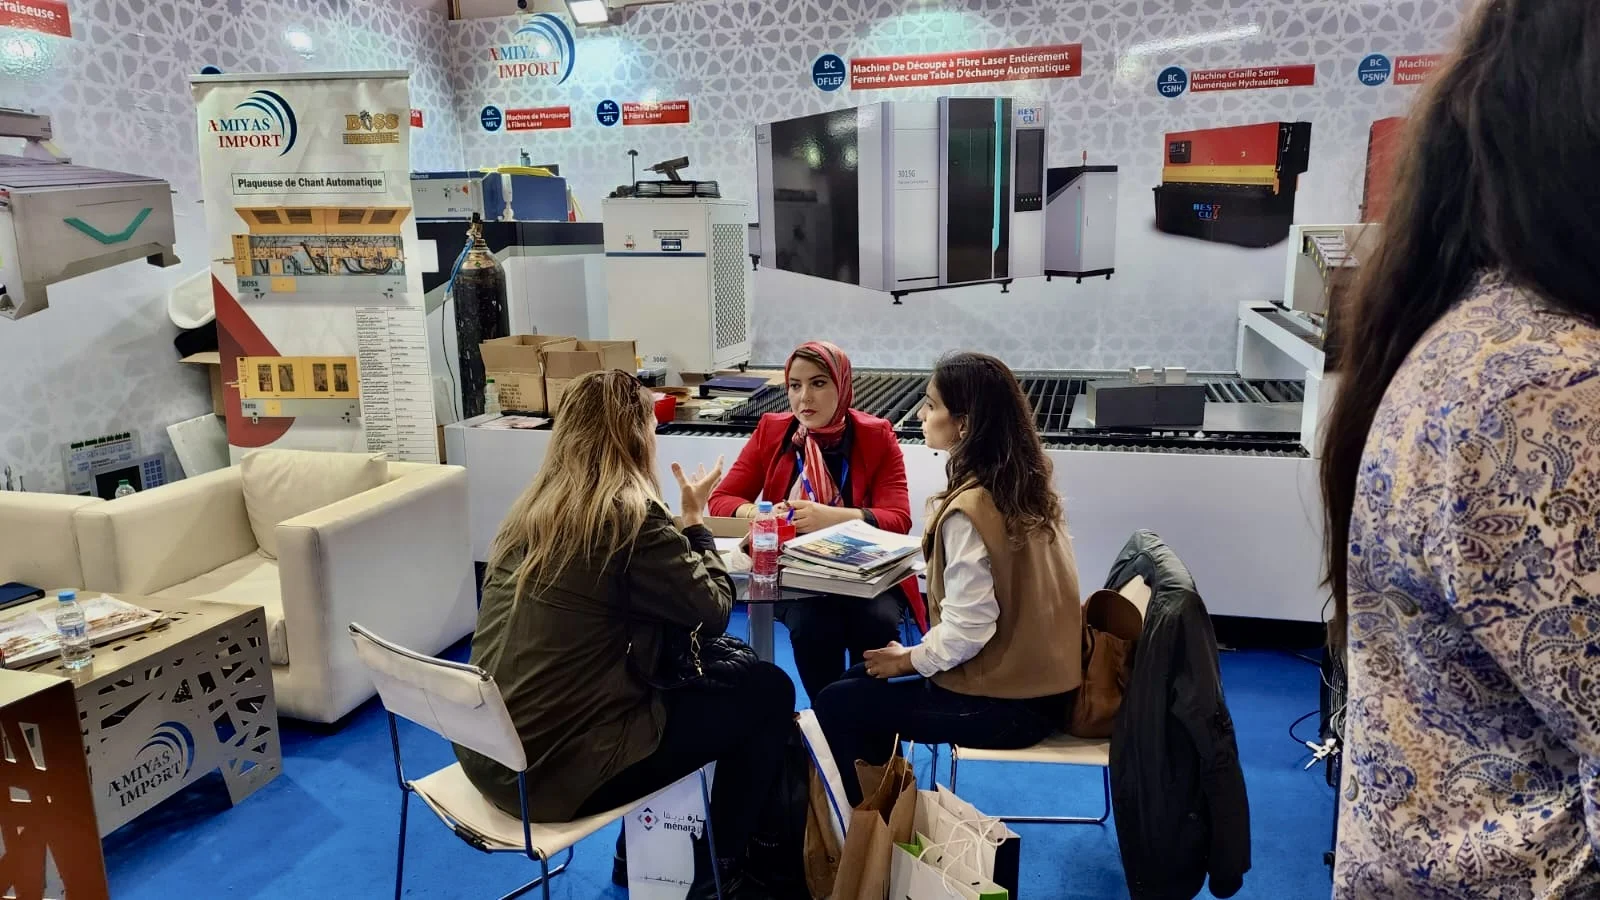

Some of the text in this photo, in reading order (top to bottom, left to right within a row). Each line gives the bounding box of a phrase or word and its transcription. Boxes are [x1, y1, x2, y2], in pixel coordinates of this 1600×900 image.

[488, 46, 541, 61] AMIYA
[824, 60, 836, 69] BC
[853, 64, 891, 73] Machine
[892, 62, 905, 71] De
[907, 60, 947, 71] Découpe
[949, 59, 955, 68] à
[957, 58, 980, 67] Fibre
[982, 56, 1007, 65] Laser
[1370, 59, 1382, 67] BC
[499, 61, 560, 78] IMPORT
[853, 63, 1071, 84] Fermée Avec une Table D'échange Automatique
[1192, 69, 1279, 81] Machine Cisaille Semi
[817, 77, 843, 86] DFLEF
[1167, 74, 1178, 82] BC
[1362, 72, 1387, 82] PSNH
[1162, 84, 1182, 93] CSNH
[1191, 78, 1289, 90] Numérique Hydraulique
[531, 112, 539, 120] de
[540, 112, 569, 120] Marquage
[208, 117, 271, 132] AMIYAS
[485, 120, 498, 128] MFL
[218, 134, 281, 148] IMPORT
[238, 177, 383, 189] Plaqueuse de Chant Automatique
[108, 750, 171, 798] AMIYAS
[120, 760, 181, 807] IMPORT
